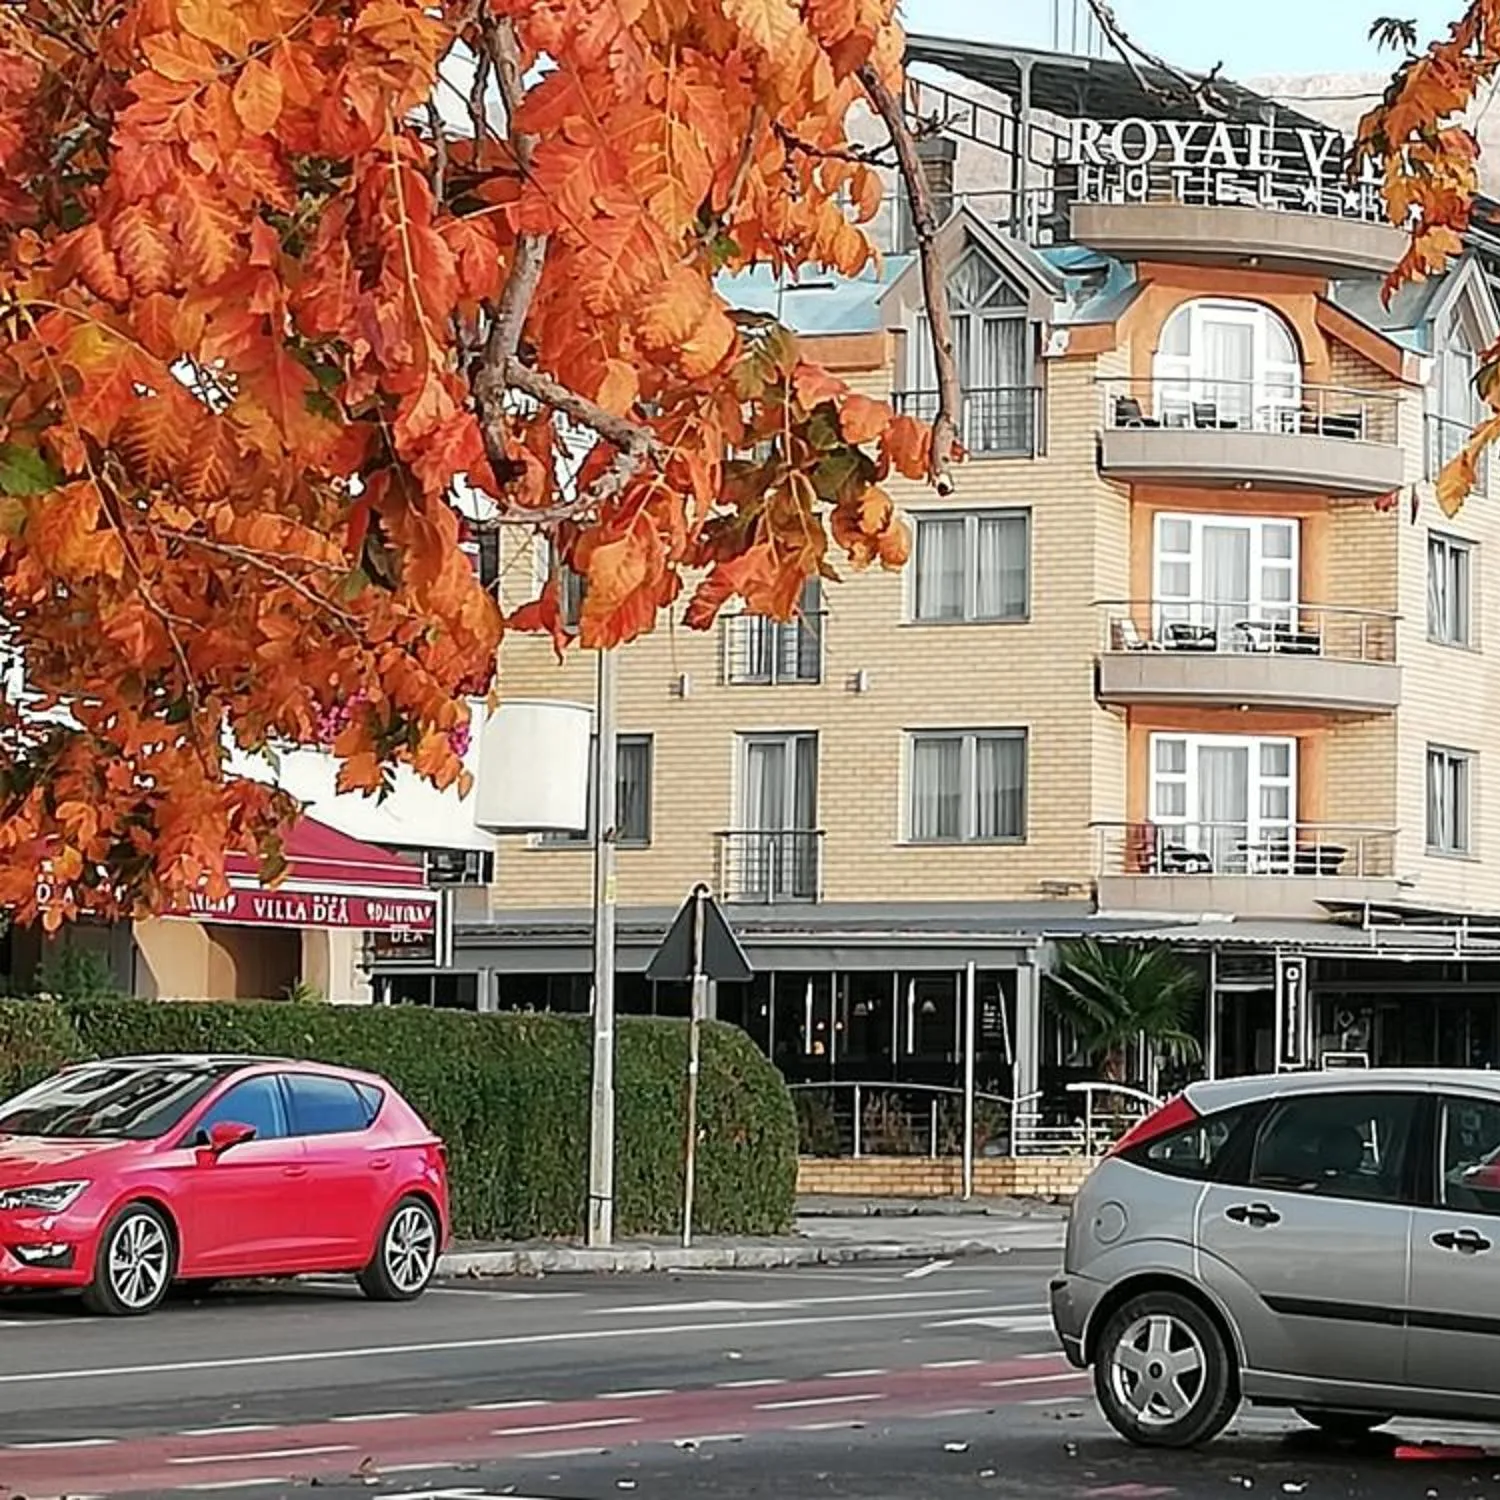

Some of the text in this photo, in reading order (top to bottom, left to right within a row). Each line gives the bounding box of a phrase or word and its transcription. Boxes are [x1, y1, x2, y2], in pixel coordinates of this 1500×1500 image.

[1068, 117, 1281, 171] ROYAL
[1078, 165, 1274, 206] HOTEL
[253, 898, 307, 922] VILLA
[312, 897, 350, 924] DEA
